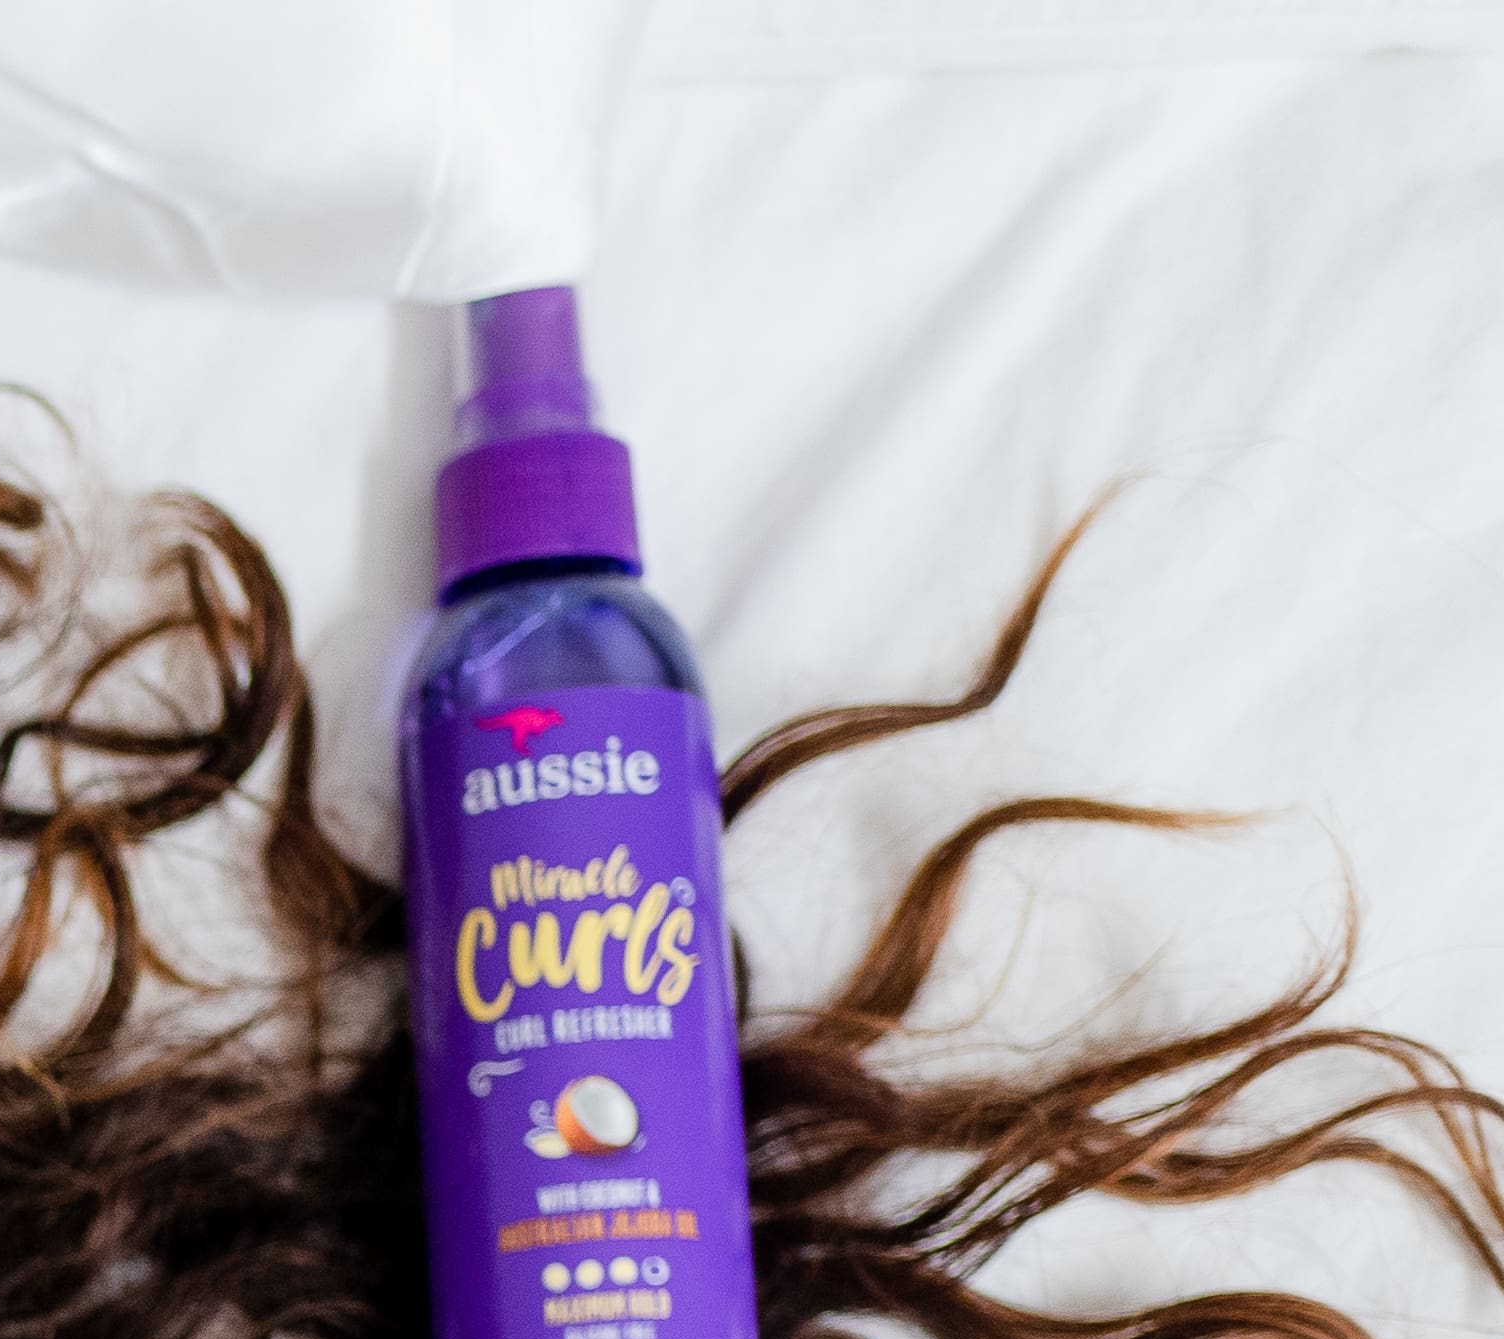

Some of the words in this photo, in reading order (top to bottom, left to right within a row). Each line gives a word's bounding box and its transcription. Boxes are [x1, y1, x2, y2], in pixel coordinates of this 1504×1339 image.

[461, 735, 660, 815] aussie
[490, 844, 641, 910] Miracle
[456, 882, 700, 1023] Curls
[495, 1014, 548, 1054] CURL
[552, 1004, 673, 1041] REFRESHER
